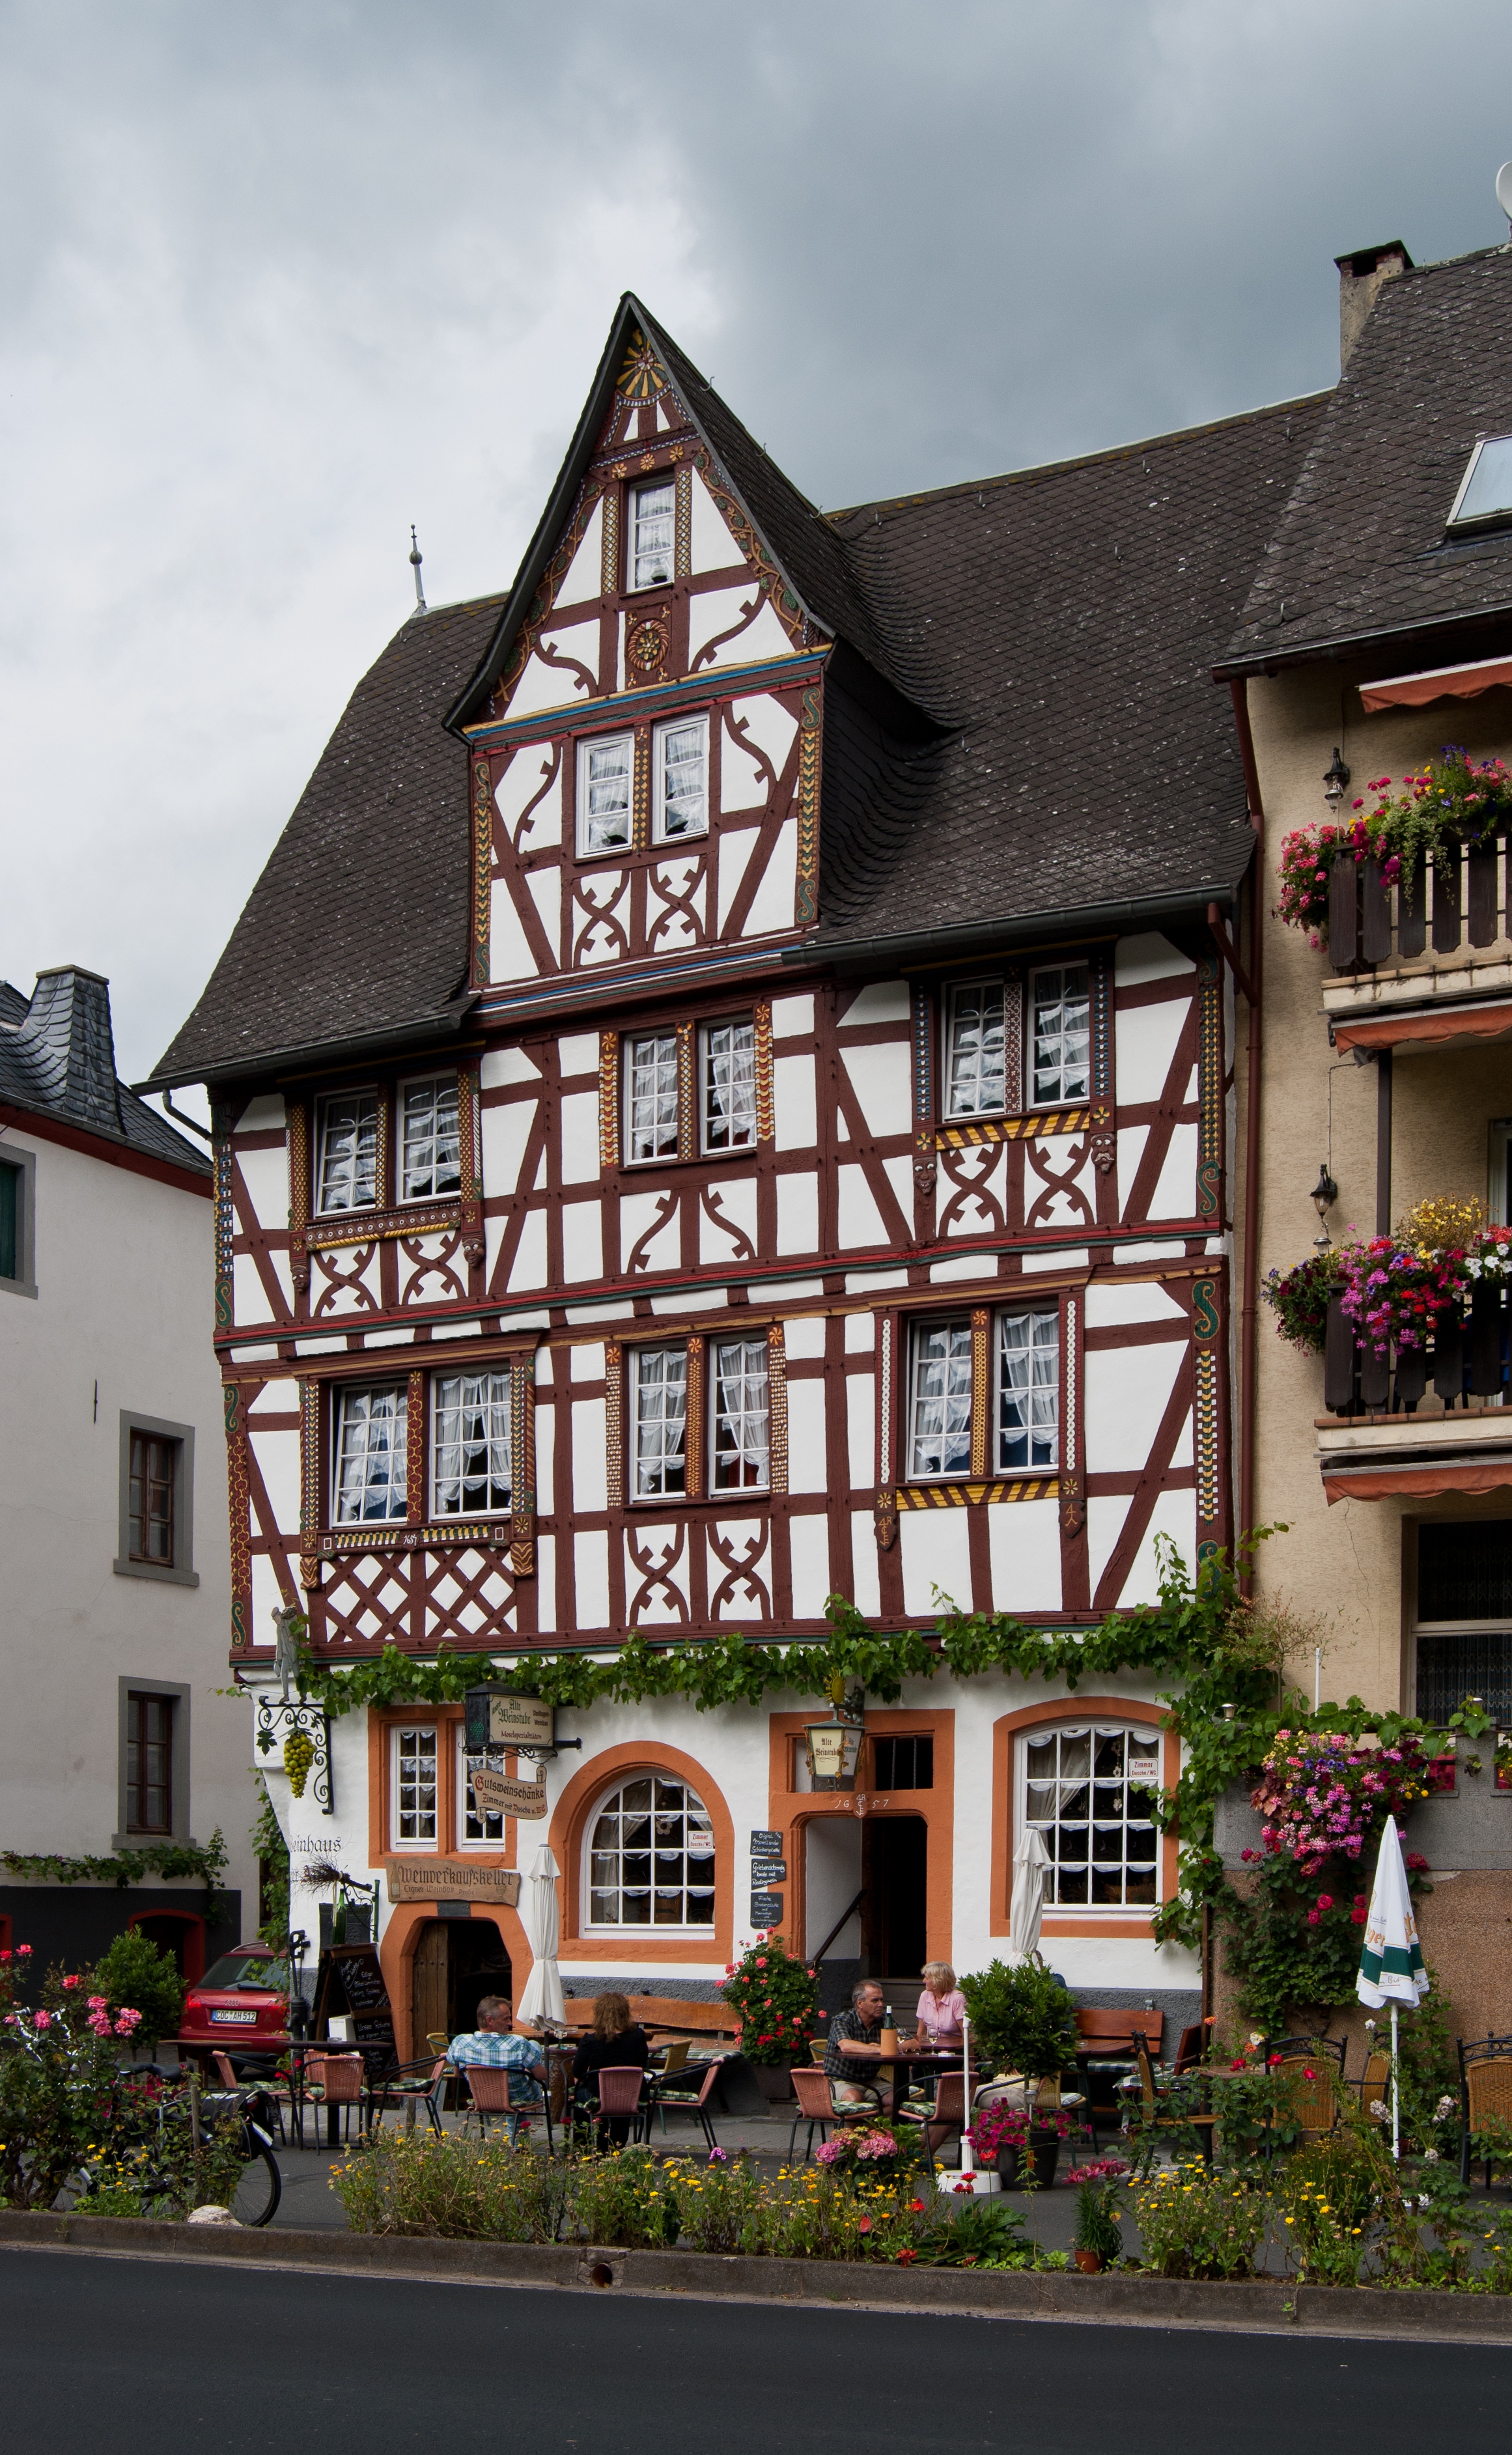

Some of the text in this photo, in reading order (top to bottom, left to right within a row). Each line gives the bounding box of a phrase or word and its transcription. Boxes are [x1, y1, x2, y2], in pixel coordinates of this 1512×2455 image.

[403, 1534, 417, 1547] 1657
[509, 1698, 521, 1711] Alte
[497, 1707, 531, 1725] Weinstube
[501, 1730, 542, 1740] Moselspezialitäten
[821, 1737, 832, 1746] Alte
[815, 1747, 837, 1756] Weinstub
[475, 1775, 544, 1801] Gutsweinschänke
[482, 1792, 505, 1807] Zimmer
[512, 1803, 531, 1814] Dusche
[397, 1865, 514, 1887] Weinverkaufskeller
[427, 1884, 455, 1893] Weinbau
[1388, 1975, 1401, 1984] Bit
[216, 2010, 229, 2019] COC
[233, 2011, 242, 2020] AH
[243, 2012, 255, 2021] 512
